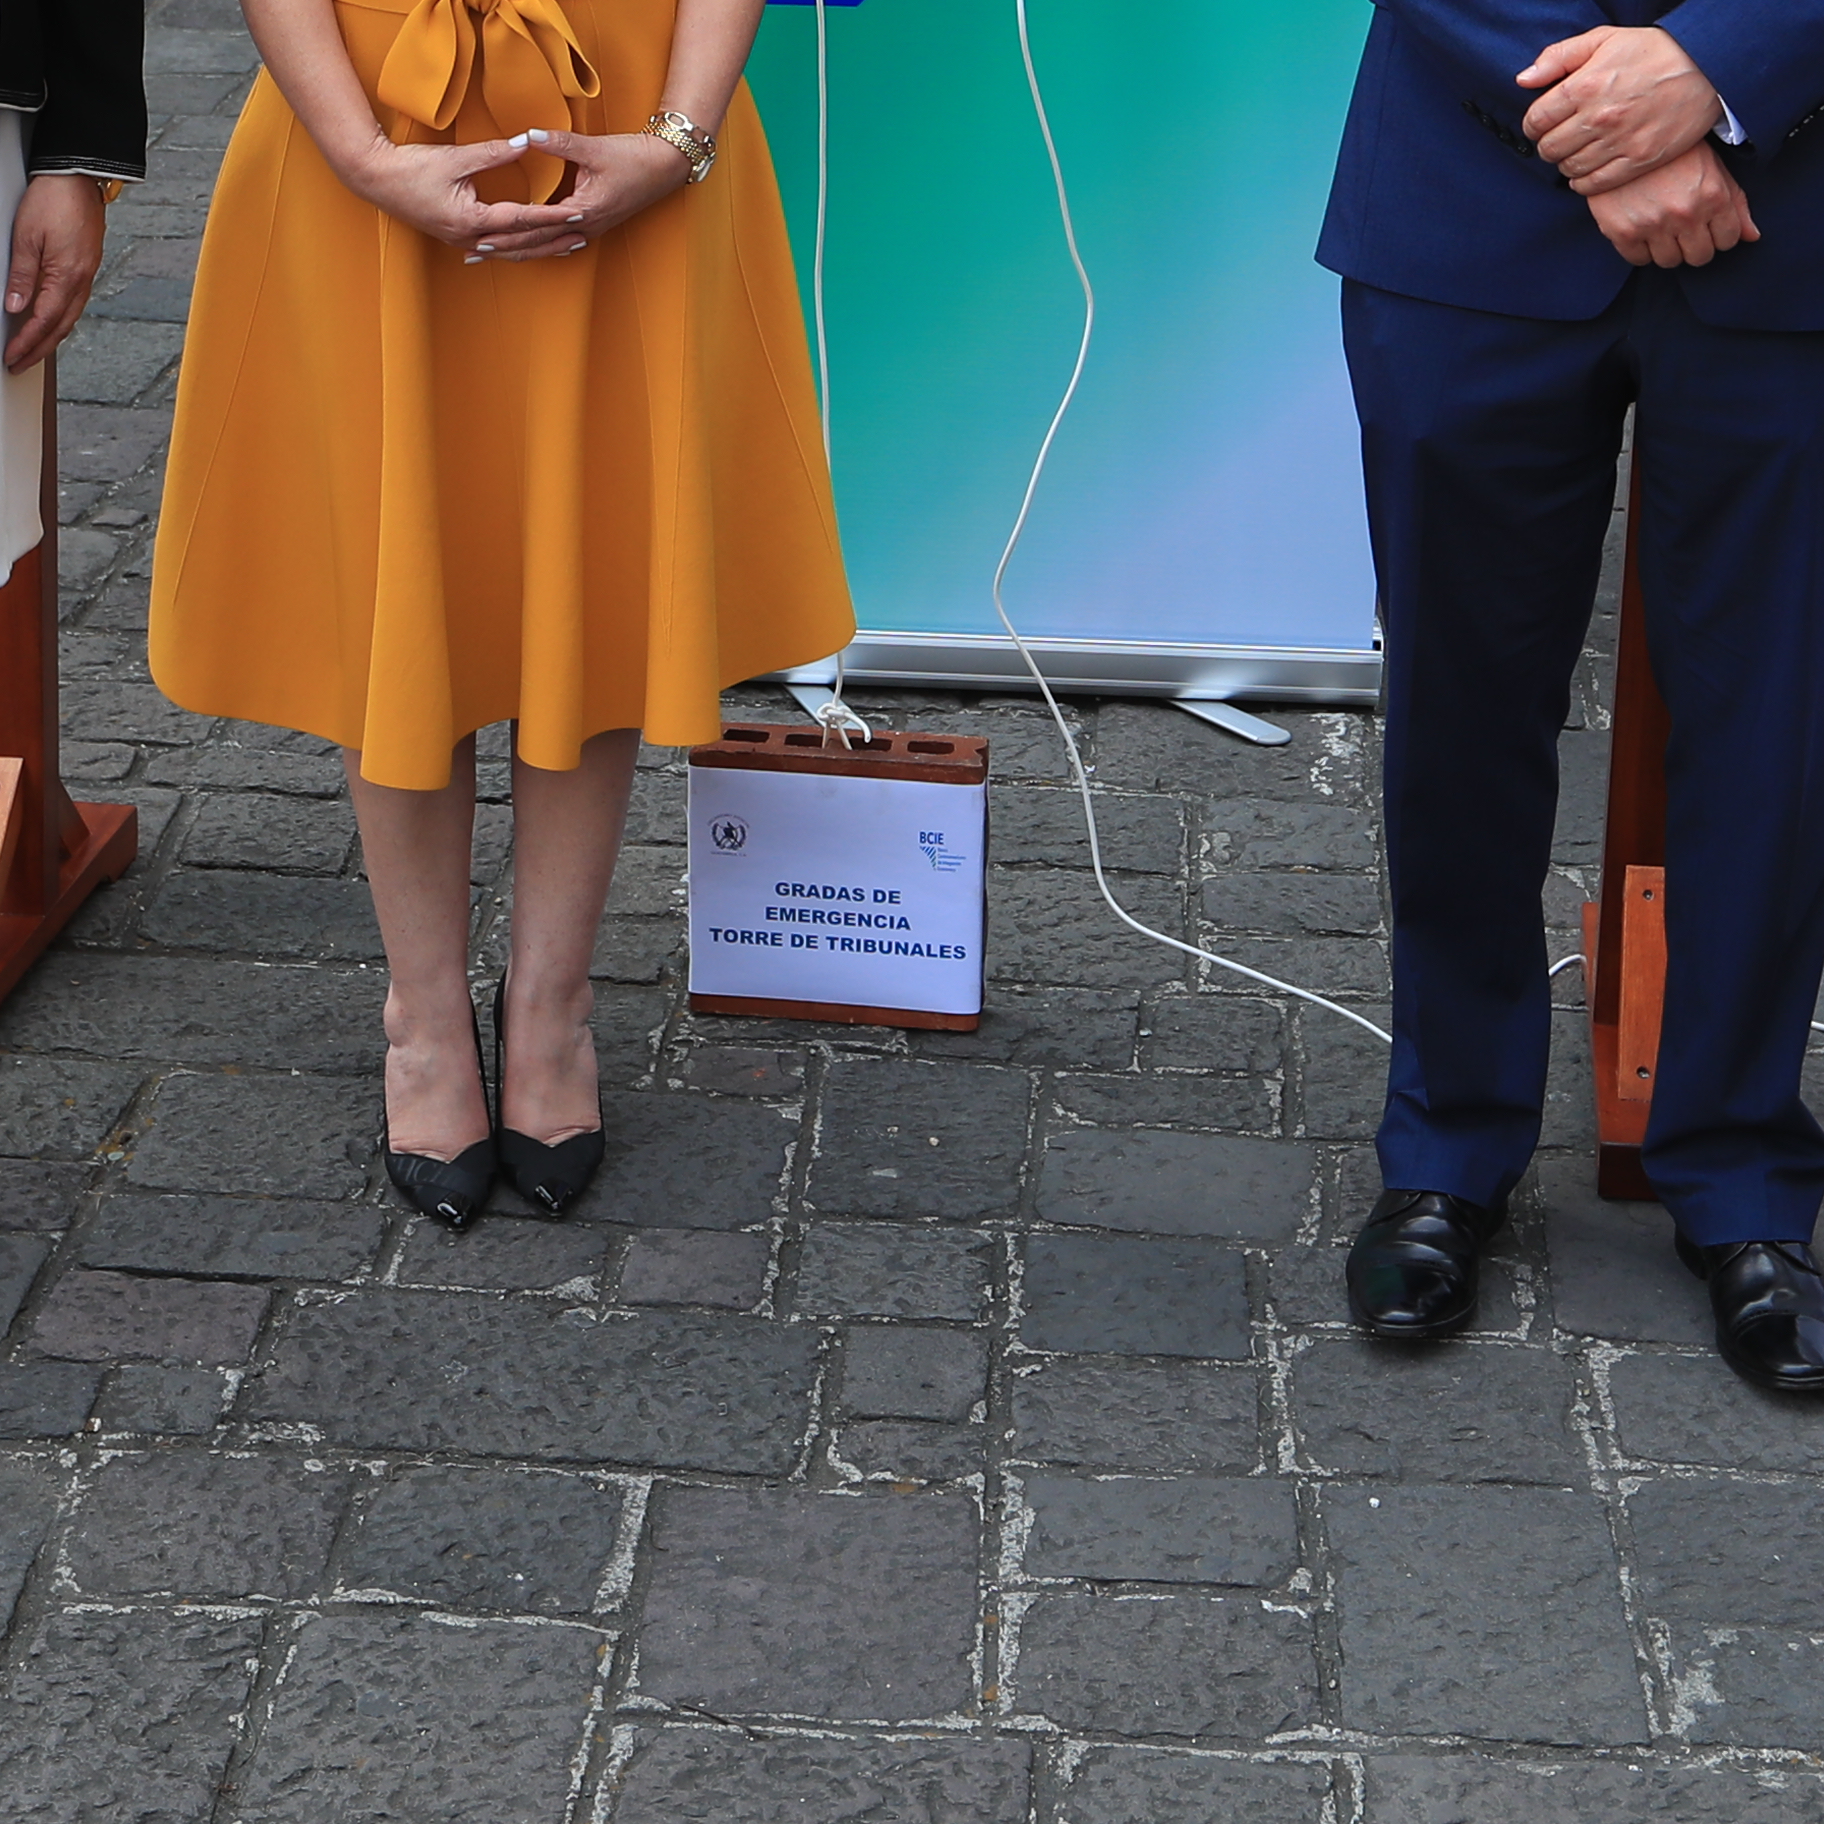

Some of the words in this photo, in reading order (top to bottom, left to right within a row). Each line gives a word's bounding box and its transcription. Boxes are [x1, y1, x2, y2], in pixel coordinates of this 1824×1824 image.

[919, 831, 944, 845] BCIE
[775, 882, 865, 902] GRADAS
[873, 889, 901, 904] DE
[765, 906, 911, 931] EMERGENCIA
[709, 928, 783, 947] TORRE
[790, 933, 818, 950] DE
[826, 936, 967, 960] TRIBUNALES
